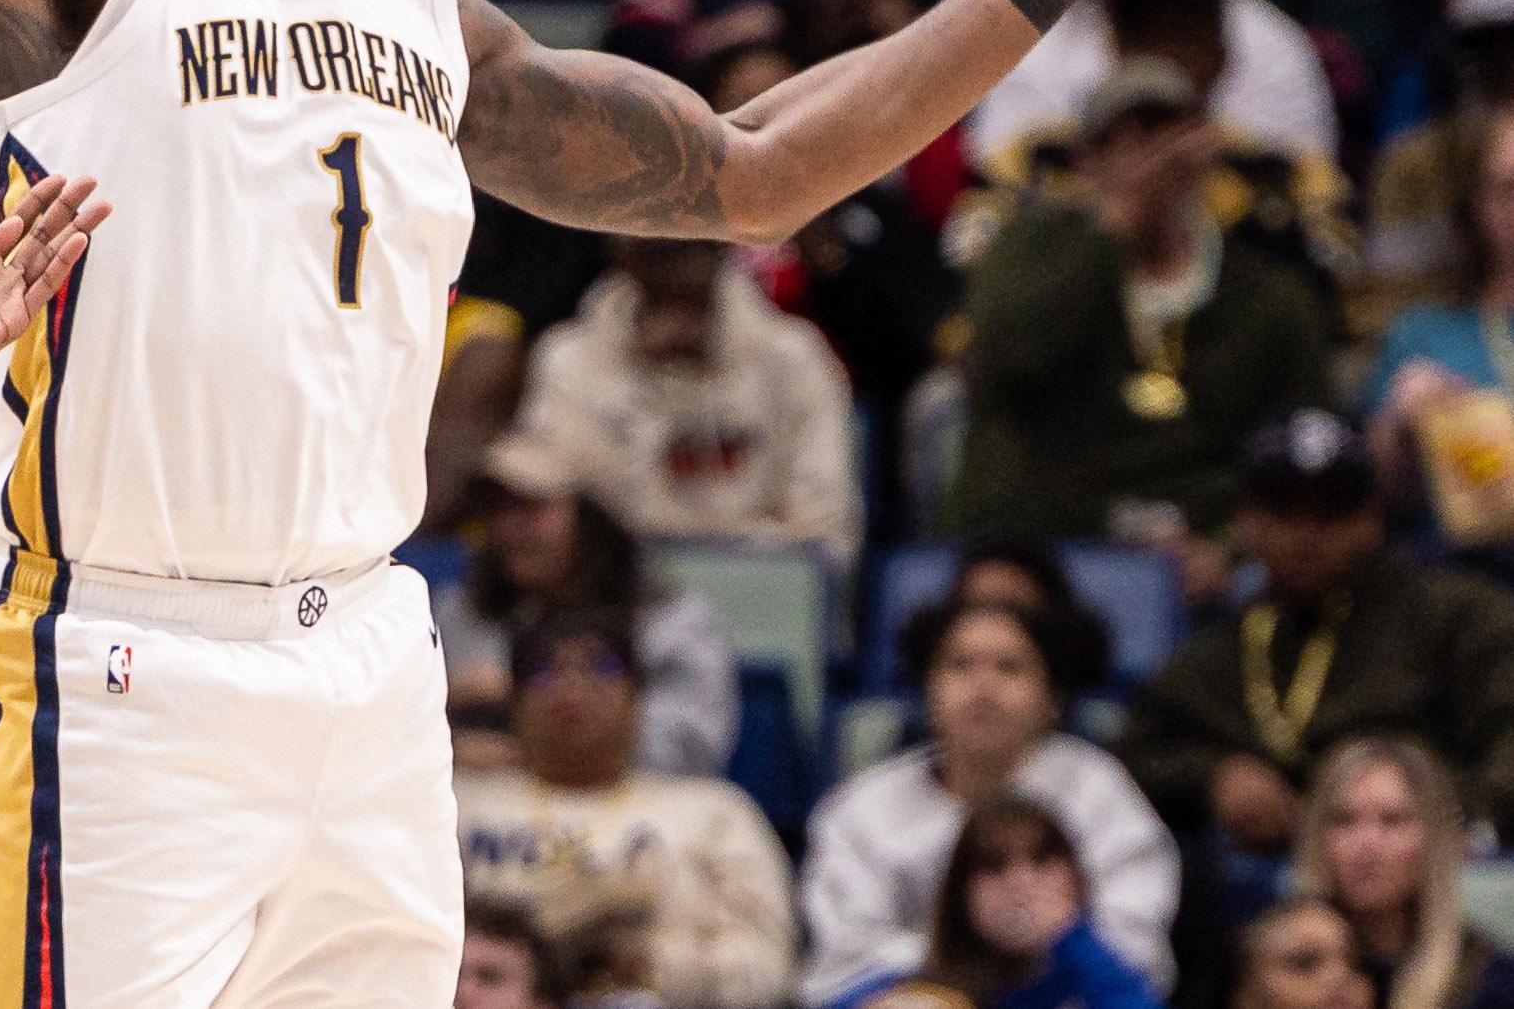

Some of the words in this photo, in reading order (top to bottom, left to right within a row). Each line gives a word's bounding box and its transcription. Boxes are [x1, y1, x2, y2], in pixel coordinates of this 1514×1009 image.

[175, 18, 278, 109] NEW
[286, 18, 459, 148] ORLEANS
[317, 131, 373, 309] 1
